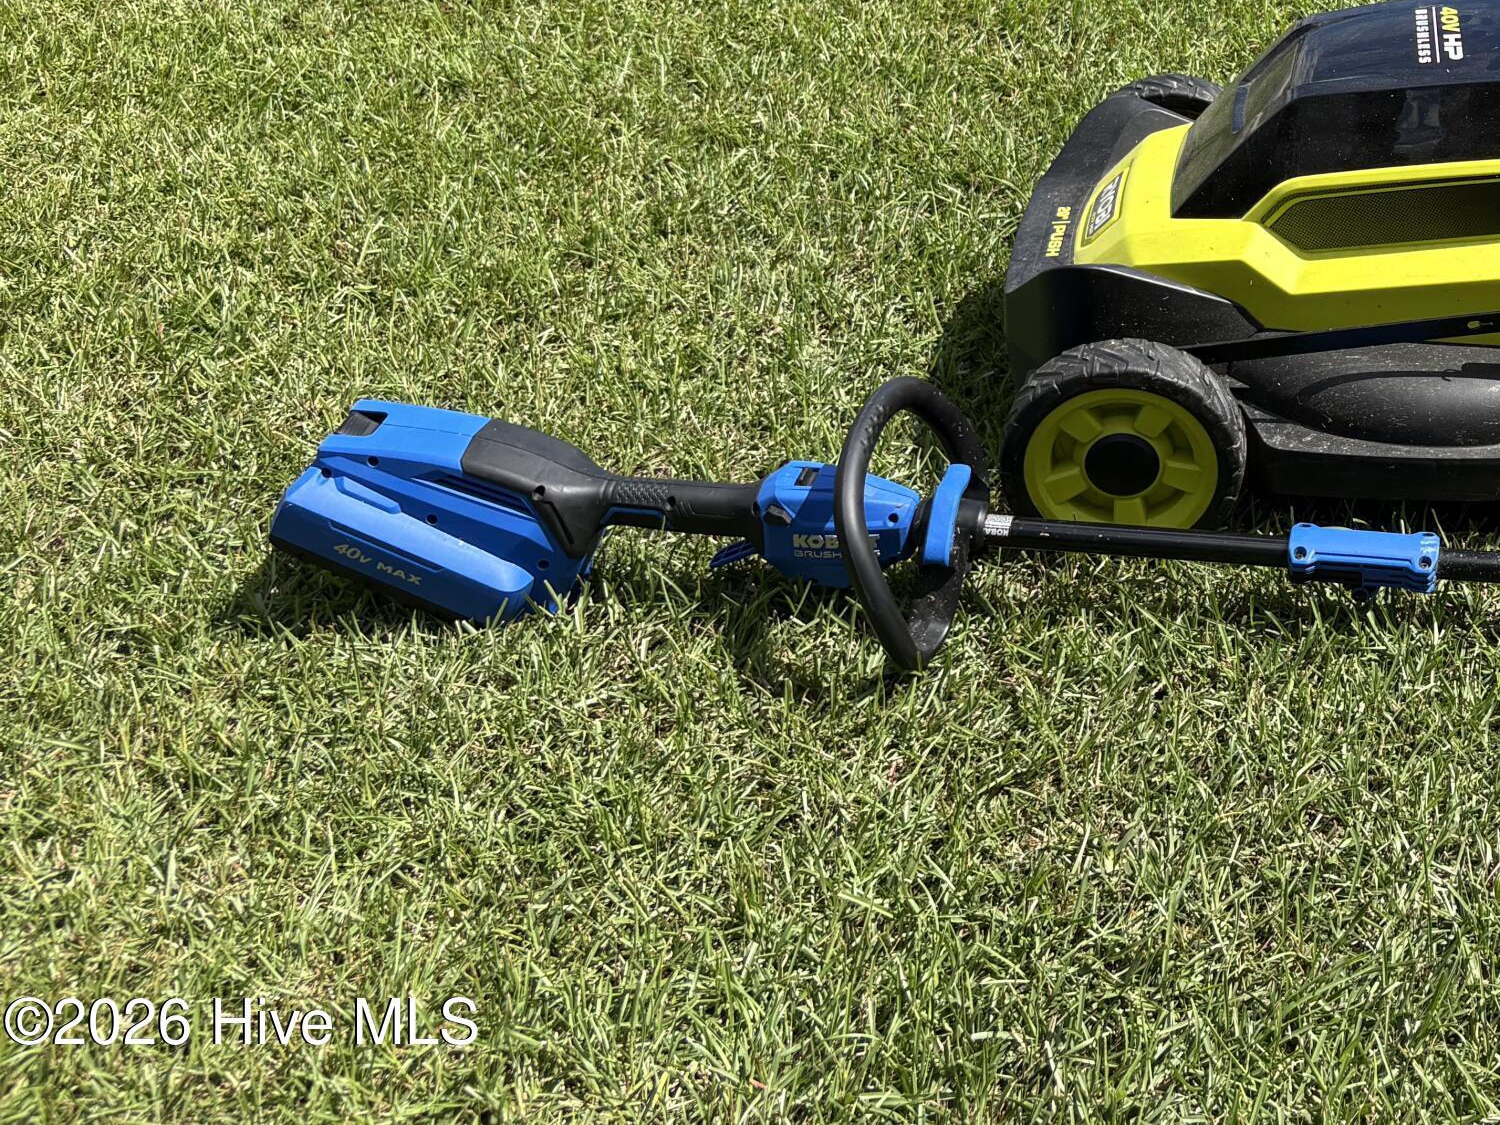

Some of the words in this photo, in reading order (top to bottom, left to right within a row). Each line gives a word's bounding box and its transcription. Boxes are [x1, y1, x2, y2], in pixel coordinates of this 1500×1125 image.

[1440, 6, 1461, 32] 40V
[1414, 8, 1432, 64] BRUSHLESS
[1443, 33, 1464, 60] HP
[1045, 224, 1067, 257] PUSH
[983, 527, 1010, 537] KOBA
[376, 562, 422, 585] MAX
